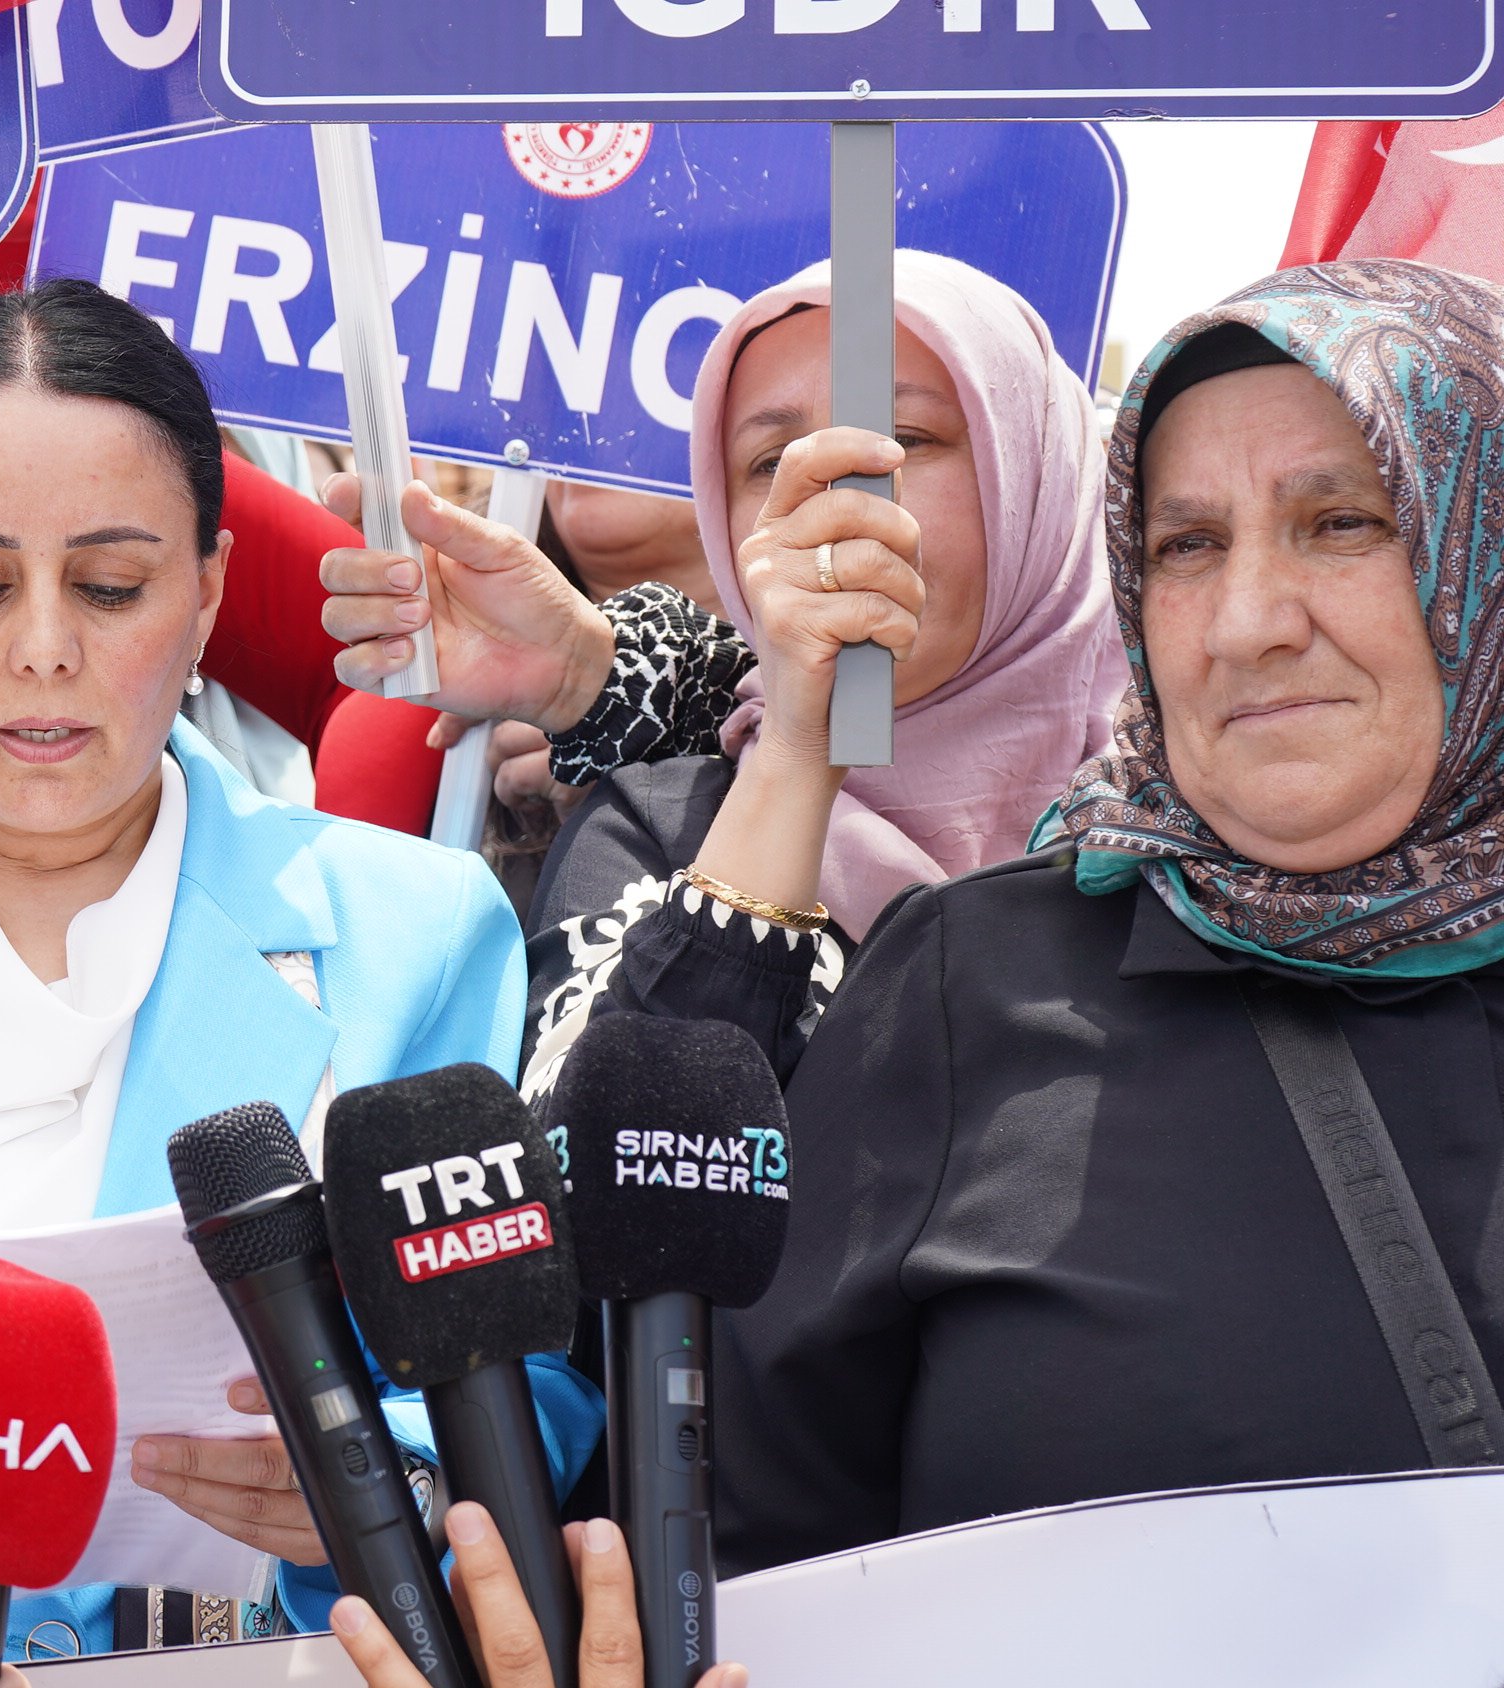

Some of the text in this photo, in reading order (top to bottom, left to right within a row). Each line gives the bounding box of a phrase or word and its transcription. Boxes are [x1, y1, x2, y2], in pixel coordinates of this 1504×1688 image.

[381, 1141, 525, 1226] TRT
[615, 1159, 751, 1194] HABER
[742, 1127, 788, 1180] 73
[402, 1209, 547, 1277] HABER
[1413, 1328, 1495, 1466] car
[405, 1610, 439, 1674] BOYA
[683, 1601, 701, 1667] BOYA
